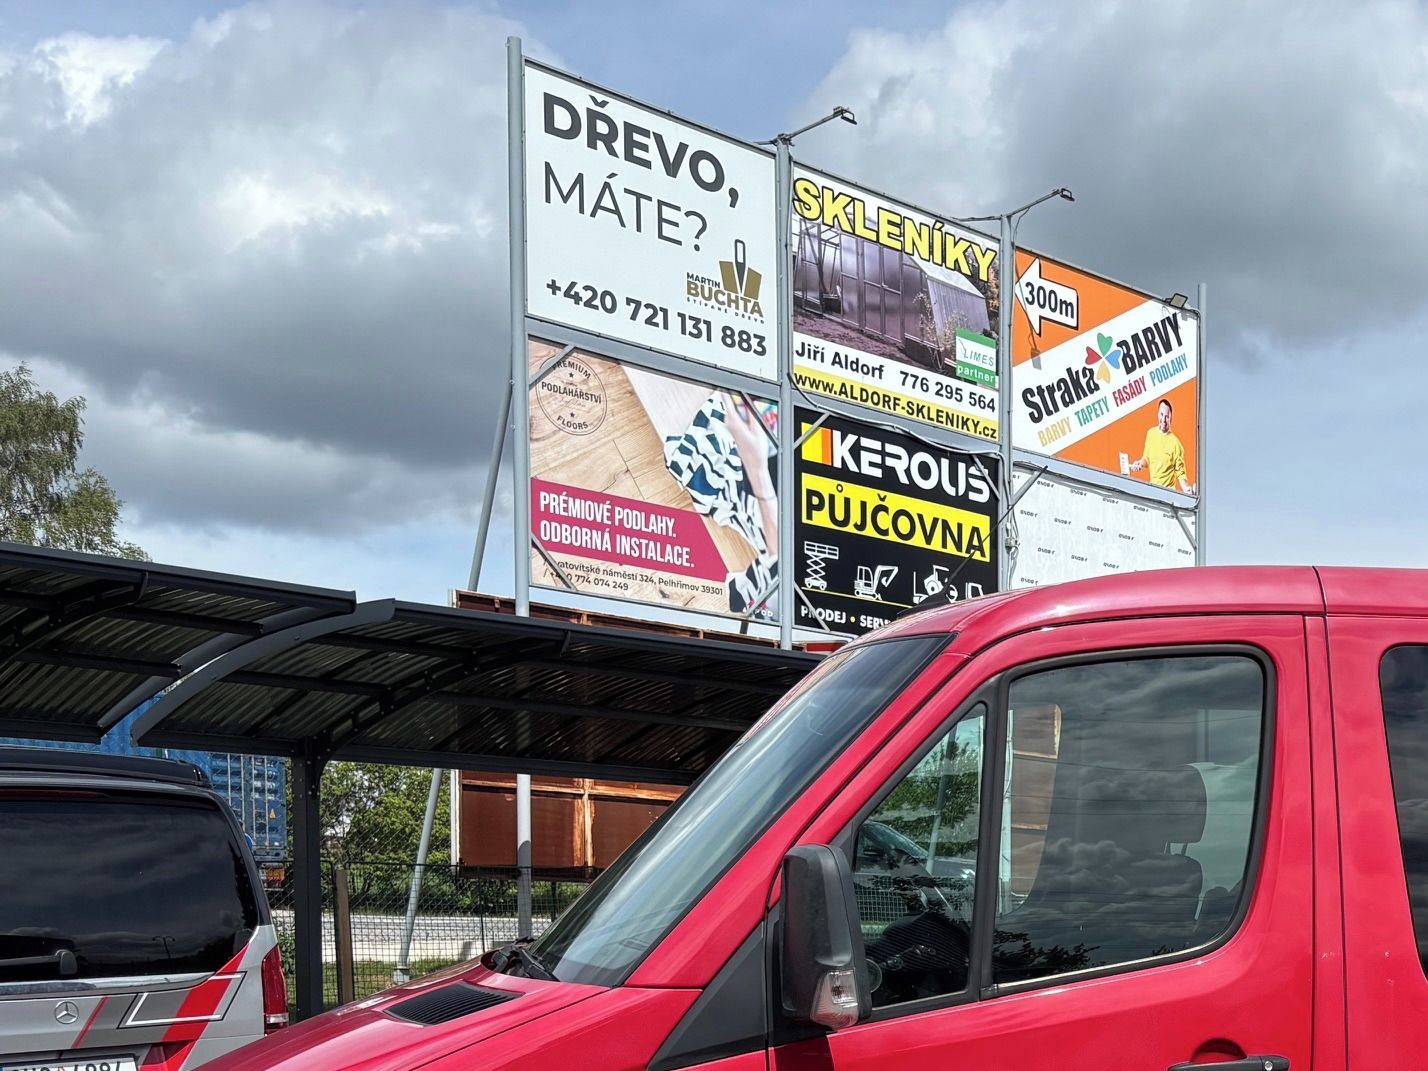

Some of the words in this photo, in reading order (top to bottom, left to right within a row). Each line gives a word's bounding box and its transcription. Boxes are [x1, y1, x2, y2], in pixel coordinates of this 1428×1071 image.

[543, 91, 739, 208] DŘEVO,
[544, 160, 708, 252] MÁTE?
[793, 178, 997, 283] SKLENÍKY
[686, 272, 720, 288] MARTIN
[687, 280, 763, 318] BUCHTA
[1025, 282, 1075, 318] 300m
[546, 279, 617, 314] +420
[625, 296, 669, 331] 721
[677, 311, 713, 343] 131
[721, 325, 767, 357] 883
[795, 341, 825, 364] Jiří
[831, 351, 884, 380] Aldorf
[900, 371, 930, 394] 776
[934, 381, 964, 403] 295
[968, 392, 996, 413] 564
[957, 365, 995, 383] partner
[1021, 366, 1100, 424] Straka
[1117, 312, 1184, 376] BARVY
[557, 415, 589, 430] FLOORS
[794, 372, 997, 440] www.ALDORF-SKLENIKY.cz
[1037, 416, 1072, 448] BARVY
[1074, 396, 1111, 428] TAPETY
[1112, 375, 1148, 408] FASÁDY
[1149, 352, 1189, 388] PODLAHY
[539, 491, 612, 523] PRÉMIOVÉ
[614, 506, 677, 538] PODLAHY.
[805, 484, 987, 558] PŮJČOVNA
[540, 520, 612, 553] ODBORNÁ
[615, 533, 695, 568] INSTALACE.
[574, 573, 591, 584] 774
[593, 577, 611, 588] 074
[612, 582, 629, 591] 249
[602, 567, 638, 581] náměstí
[639, 573, 657, 585] 324,
[658, 577, 700, 592] Pelhřimov
[700, 584, 723, 596] 39301
